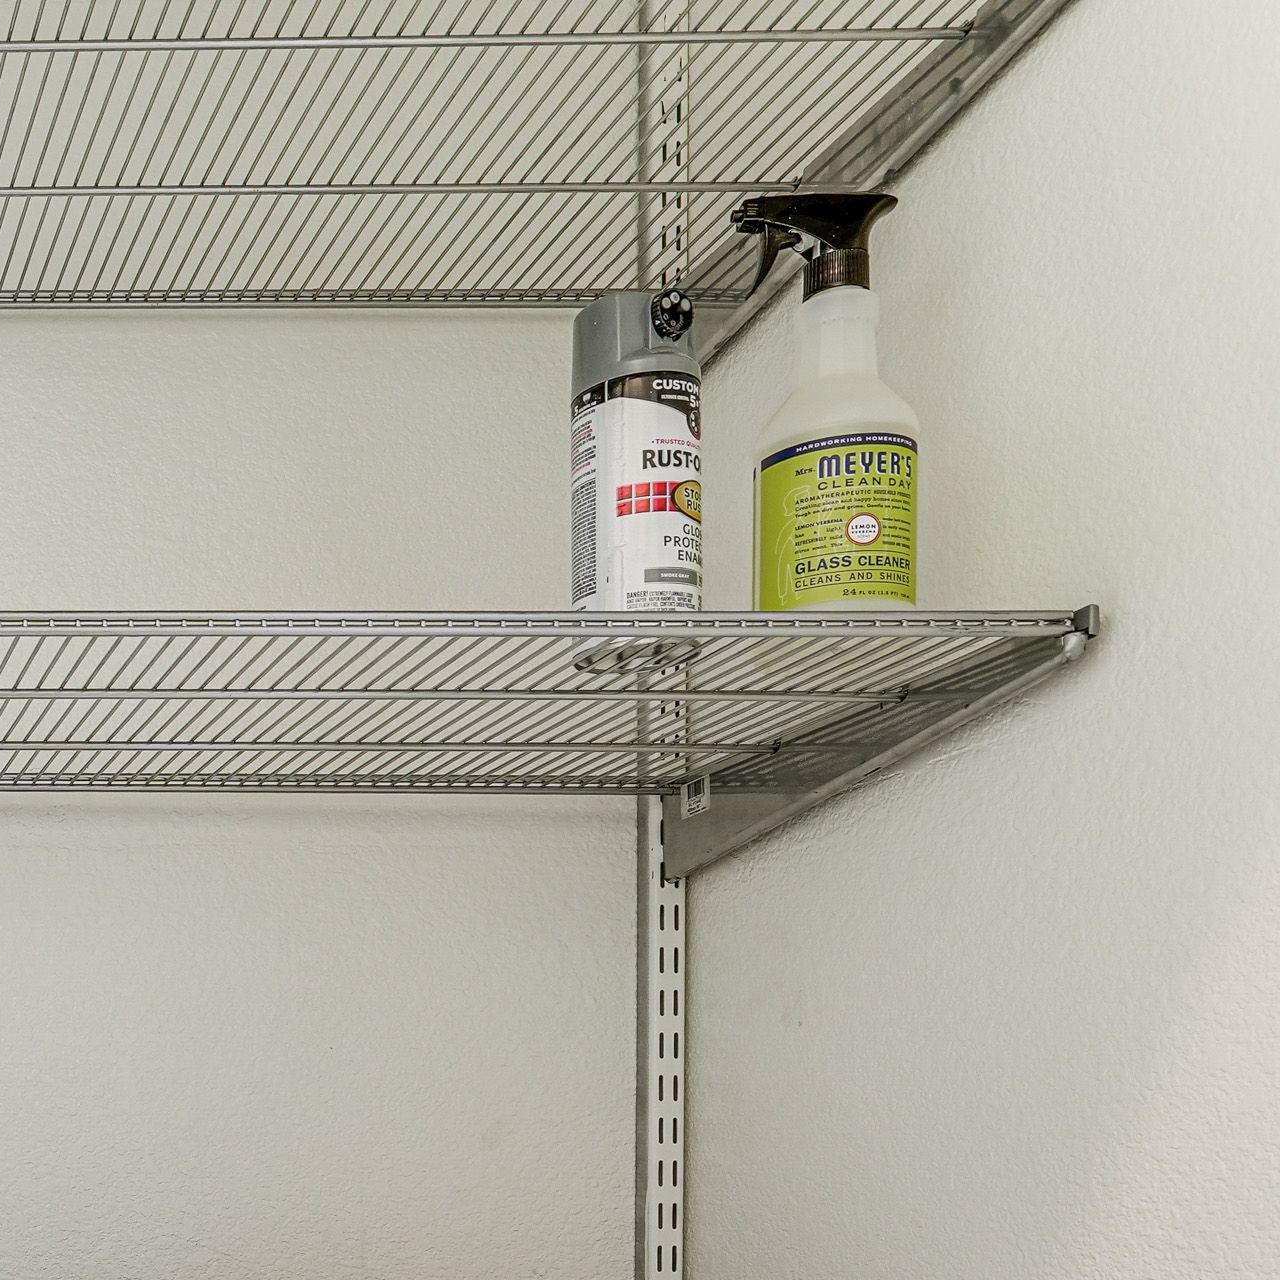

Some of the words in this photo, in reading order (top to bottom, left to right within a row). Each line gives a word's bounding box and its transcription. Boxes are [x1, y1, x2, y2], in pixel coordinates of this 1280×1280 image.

[655, 438, 685, 447] TRUSTED
[796, 435, 863, 453] HARDWORKING
[865, 435, 913, 447] HOMEKEEPING
[794, 466, 817, 478] Mrs.
[817, 477, 882, 491] CLEAN
[888, 477, 912, 490] DAY
[794, 489, 872, 505] AROMATHERAPEUTIC
[794, 522, 815, 532] LEMON
[815, 518, 843, 527] VERBENA
[795, 555, 852, 575] GLASS
[858, 555, 910, 571] CLEANER
[794, 573, 842, 590] CLEANS
[849, 572, 873, 580] AND
[879, 572, 911, 584] SHINES
[842, 588, 856, 596] 24
